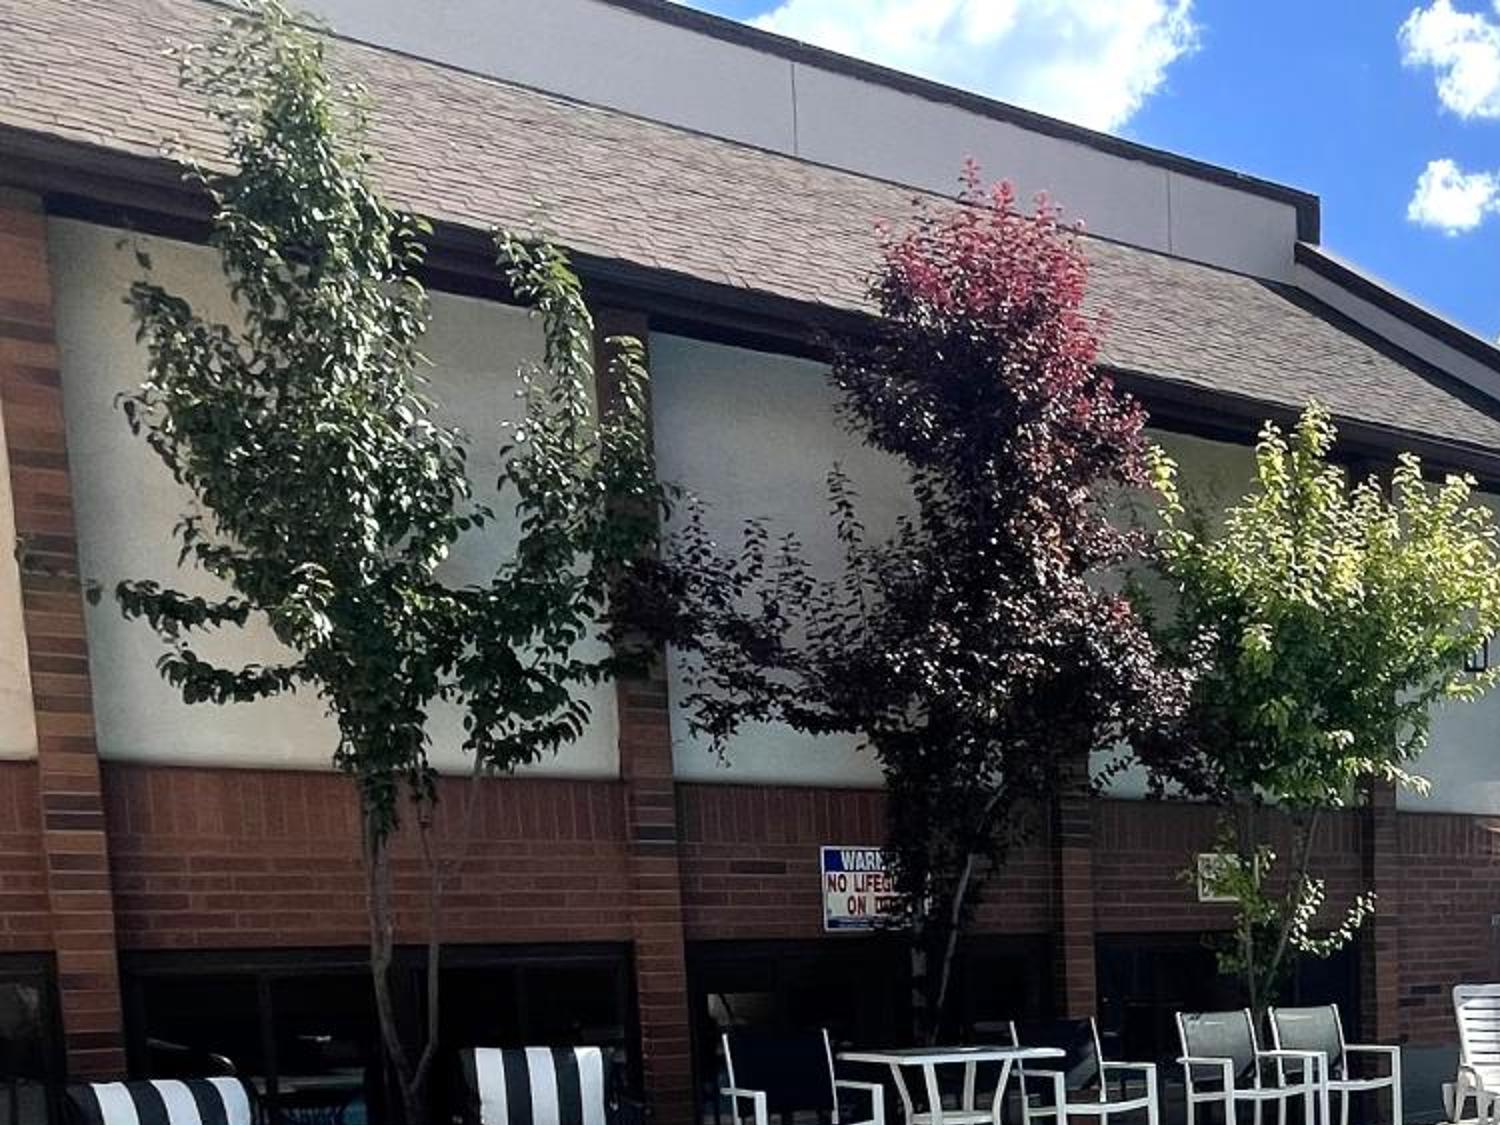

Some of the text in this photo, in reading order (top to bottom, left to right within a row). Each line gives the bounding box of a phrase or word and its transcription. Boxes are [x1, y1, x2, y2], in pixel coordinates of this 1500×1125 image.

[828, 874, 897, 892] NO LIFEG
[847, 896, 866, 914] ON
